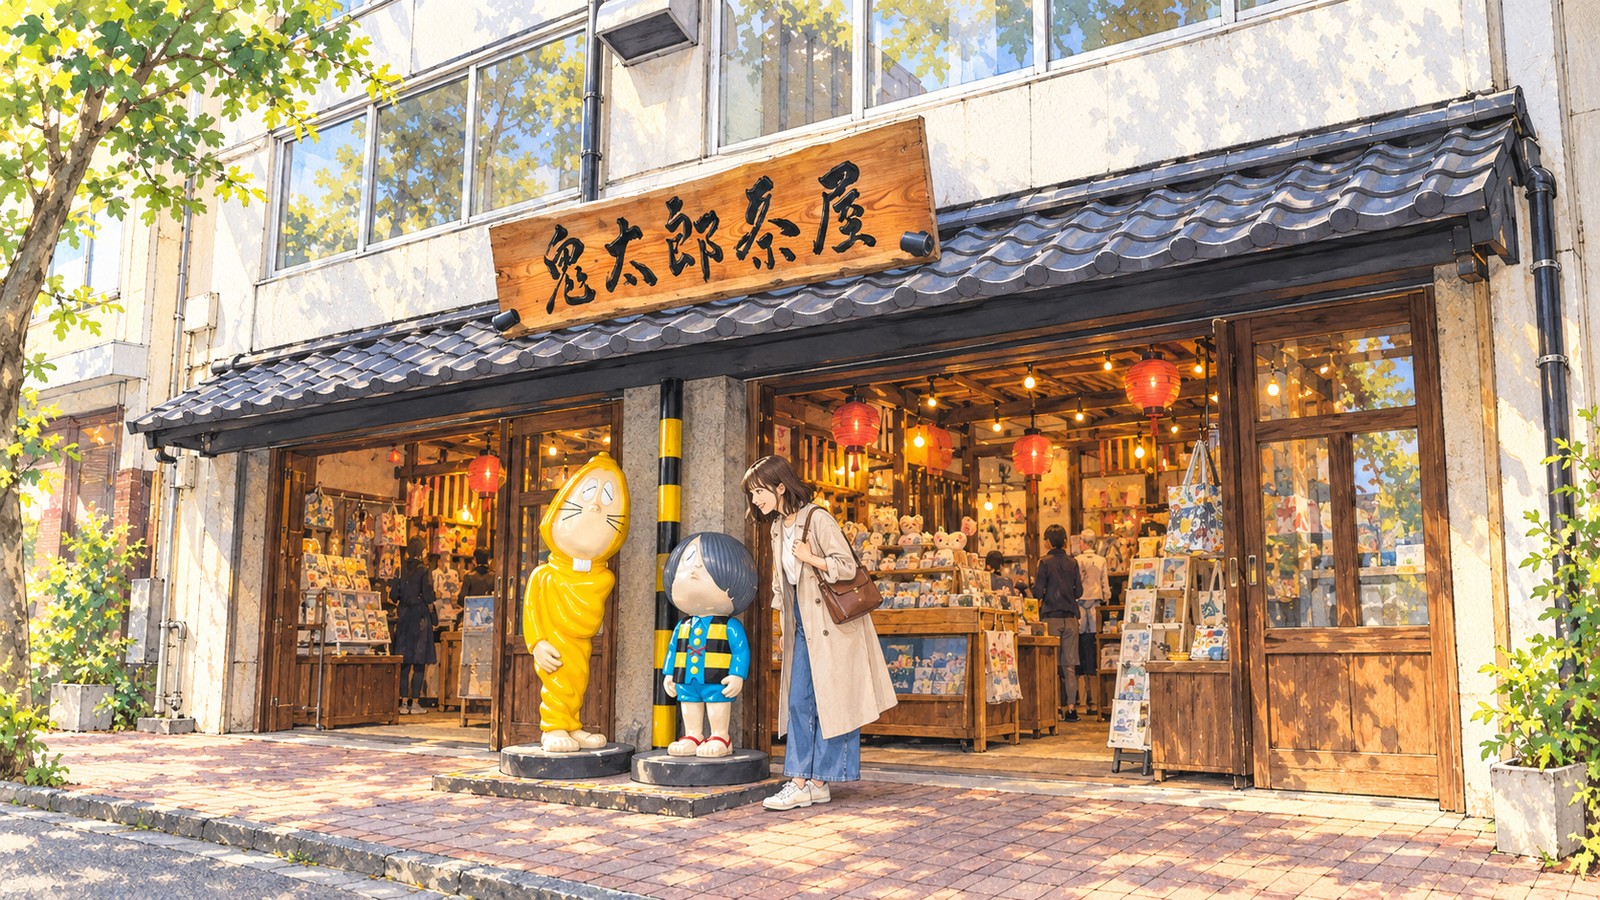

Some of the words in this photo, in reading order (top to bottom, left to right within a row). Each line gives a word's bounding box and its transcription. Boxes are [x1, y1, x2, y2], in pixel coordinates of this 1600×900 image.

[544, 160, 876, 314] 鬼太郎茶屋
